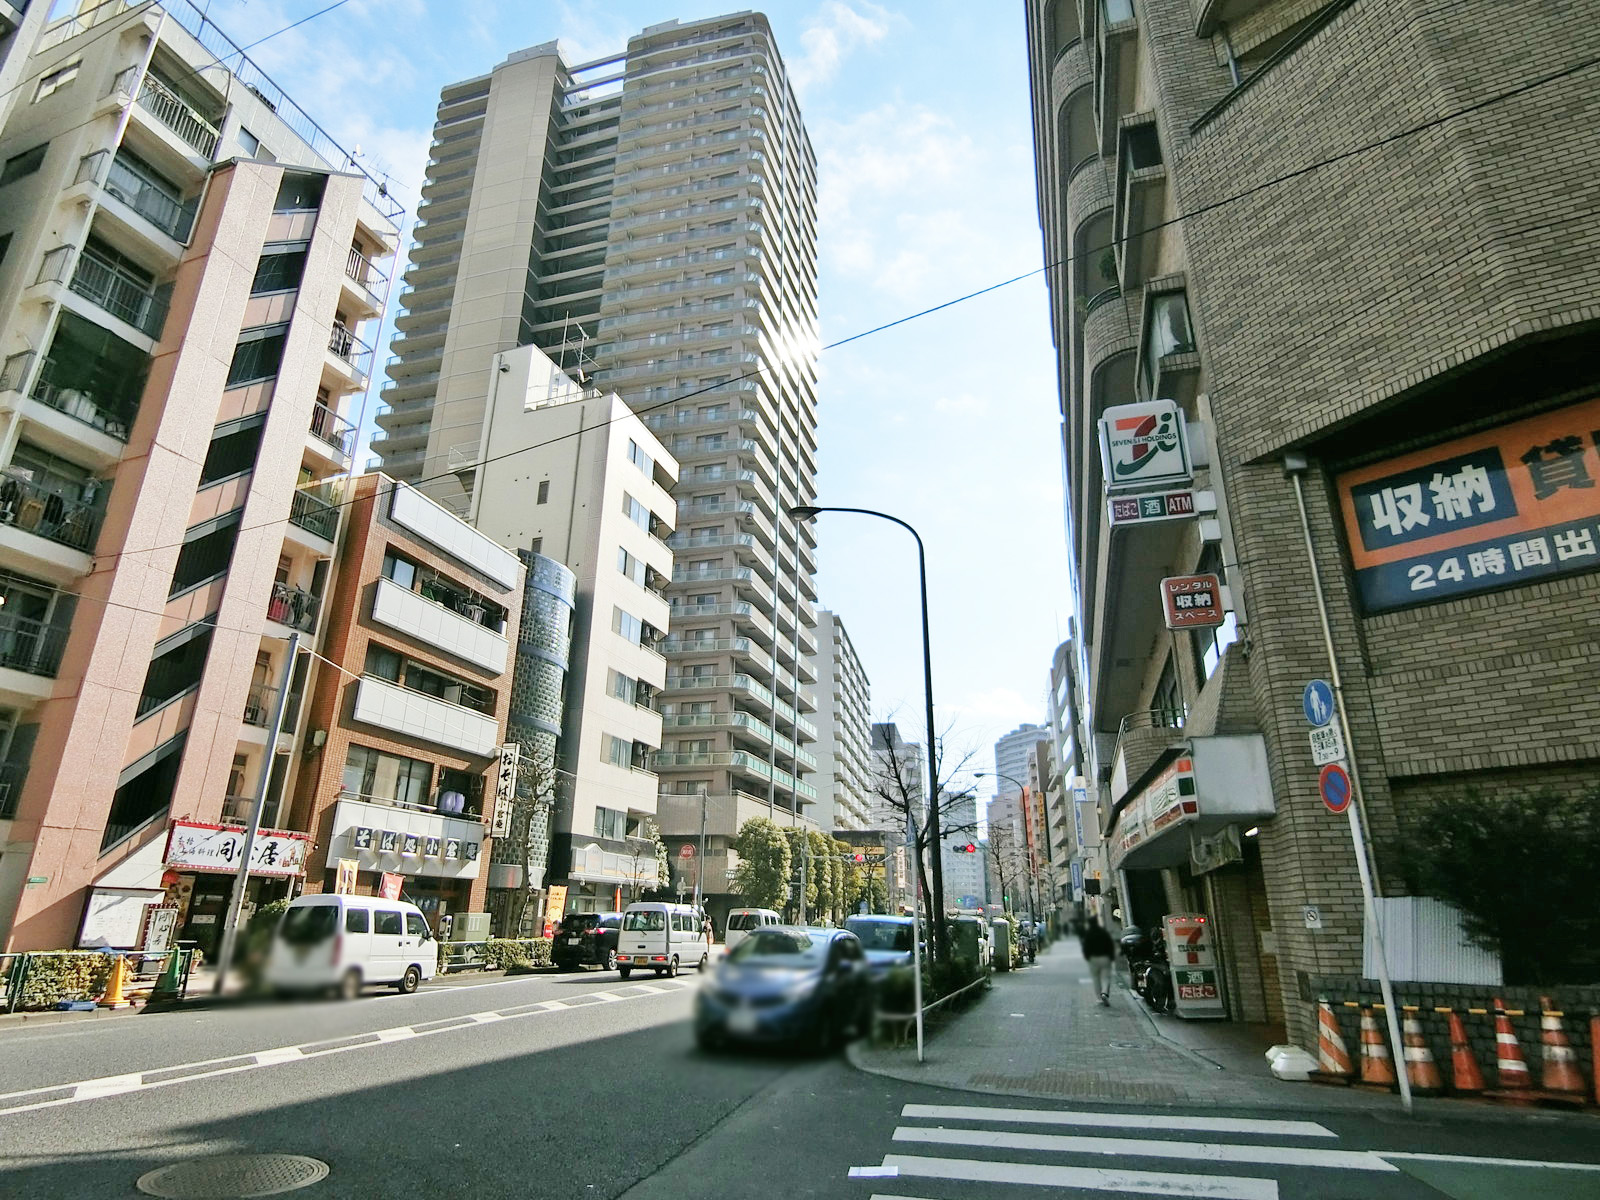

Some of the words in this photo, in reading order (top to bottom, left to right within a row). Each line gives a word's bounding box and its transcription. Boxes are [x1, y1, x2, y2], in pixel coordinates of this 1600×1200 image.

[1142, 433, 1177, 443] HOLDINGS
[1369, 464, 1496, 536] 収納
[1520, 435, 1596, 501] 貸
[1114, 502, 1138, 518] たばこ
[1145, 499, 1161, 515] 酒
[1168, 496, 1192, 512] ATM
[1407, 527, 1600, 591] 24時間出
[1169, 581, 1212, 592] レンタル
[1176, 593, 1212, 608] 収納
[1175, 610, 1218, 621] スペース
[1187, 971, 1204, 984] 酒
[1181, 985, 1216, 998] たばこ
